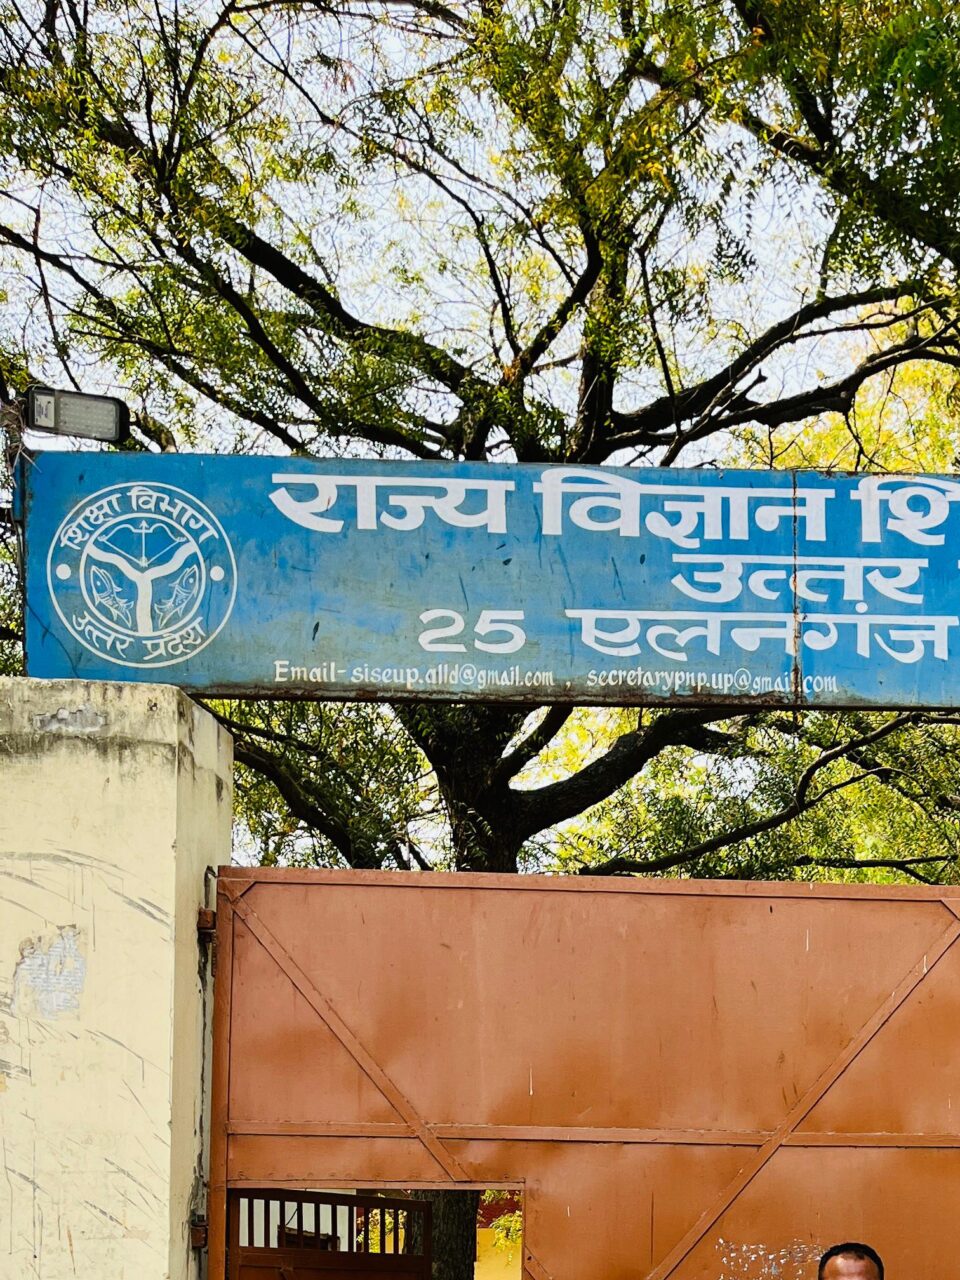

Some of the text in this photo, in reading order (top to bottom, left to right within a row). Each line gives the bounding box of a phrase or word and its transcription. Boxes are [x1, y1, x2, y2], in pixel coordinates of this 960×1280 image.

[60, 486, 219, 550] शिक्षा विभाग
[269, 472, 516, 534] राज्य
[533, 467, 836, 549] विज्ञान
[671, 554, 929, 604] उत्तर
[73, 611, 206, 660] उत्तर प्रदेश
[417, 609, 527, 654] 25
